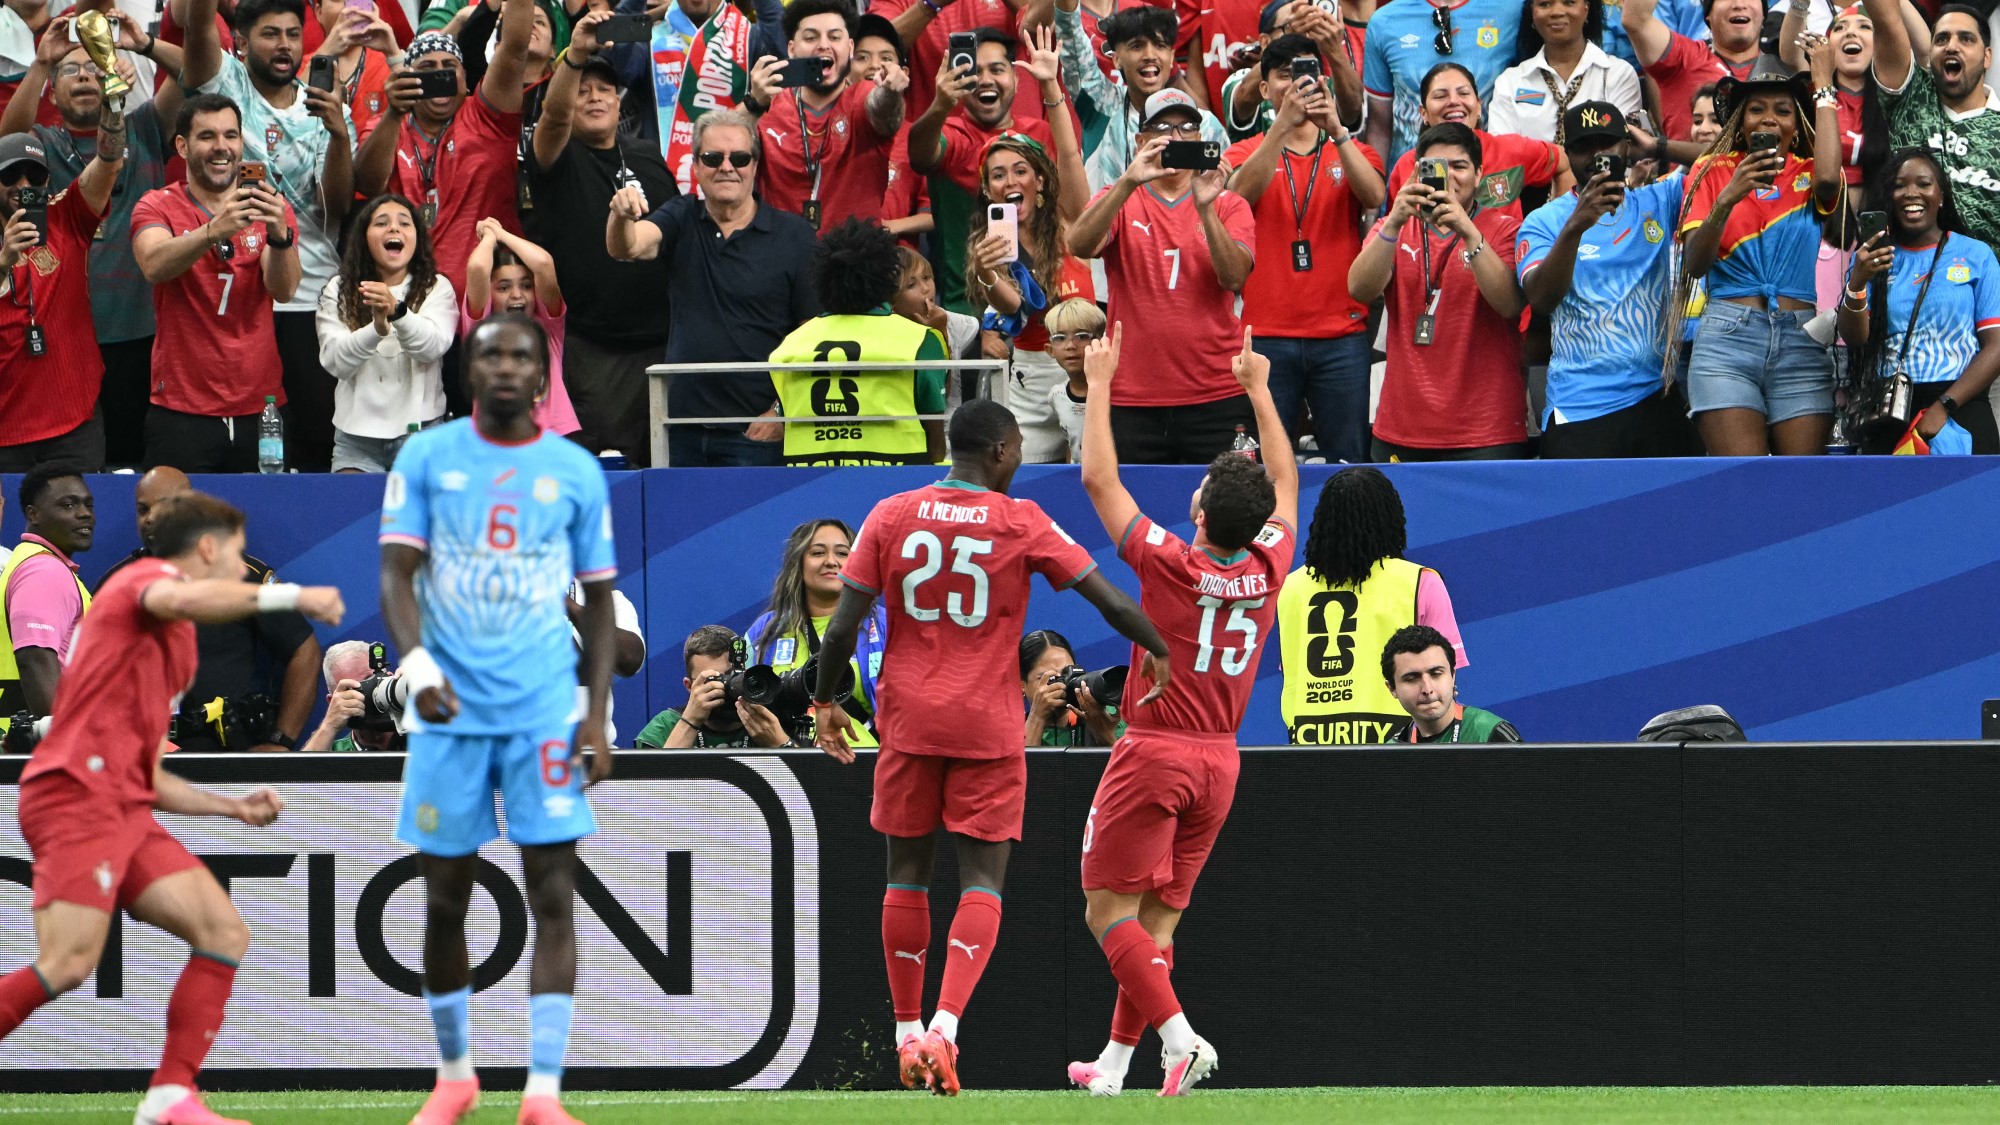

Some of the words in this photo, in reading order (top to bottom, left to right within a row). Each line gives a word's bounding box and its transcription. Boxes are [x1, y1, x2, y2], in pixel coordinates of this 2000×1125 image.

[1163, 247, 1180, 290] 7
[217, 272, 234, 316] 7
[824, 402, 848, 414] FIFA
[814, 428, 863, 442] 2026
[487, 504, 519, 550] 6
[901, 530, 993, 628] 25
[27, 622, 55, 632] SECURITY
[1193, 596, 1266, 677] 15
[1321, 659, 1343, 671] FIFA
[1306, 680, 1338, 690] WORLD
[1338, 679, 1353, 688] CUP
[1306, 689, 1353, 704] 2026
[539, 739, 572, 789] 6
